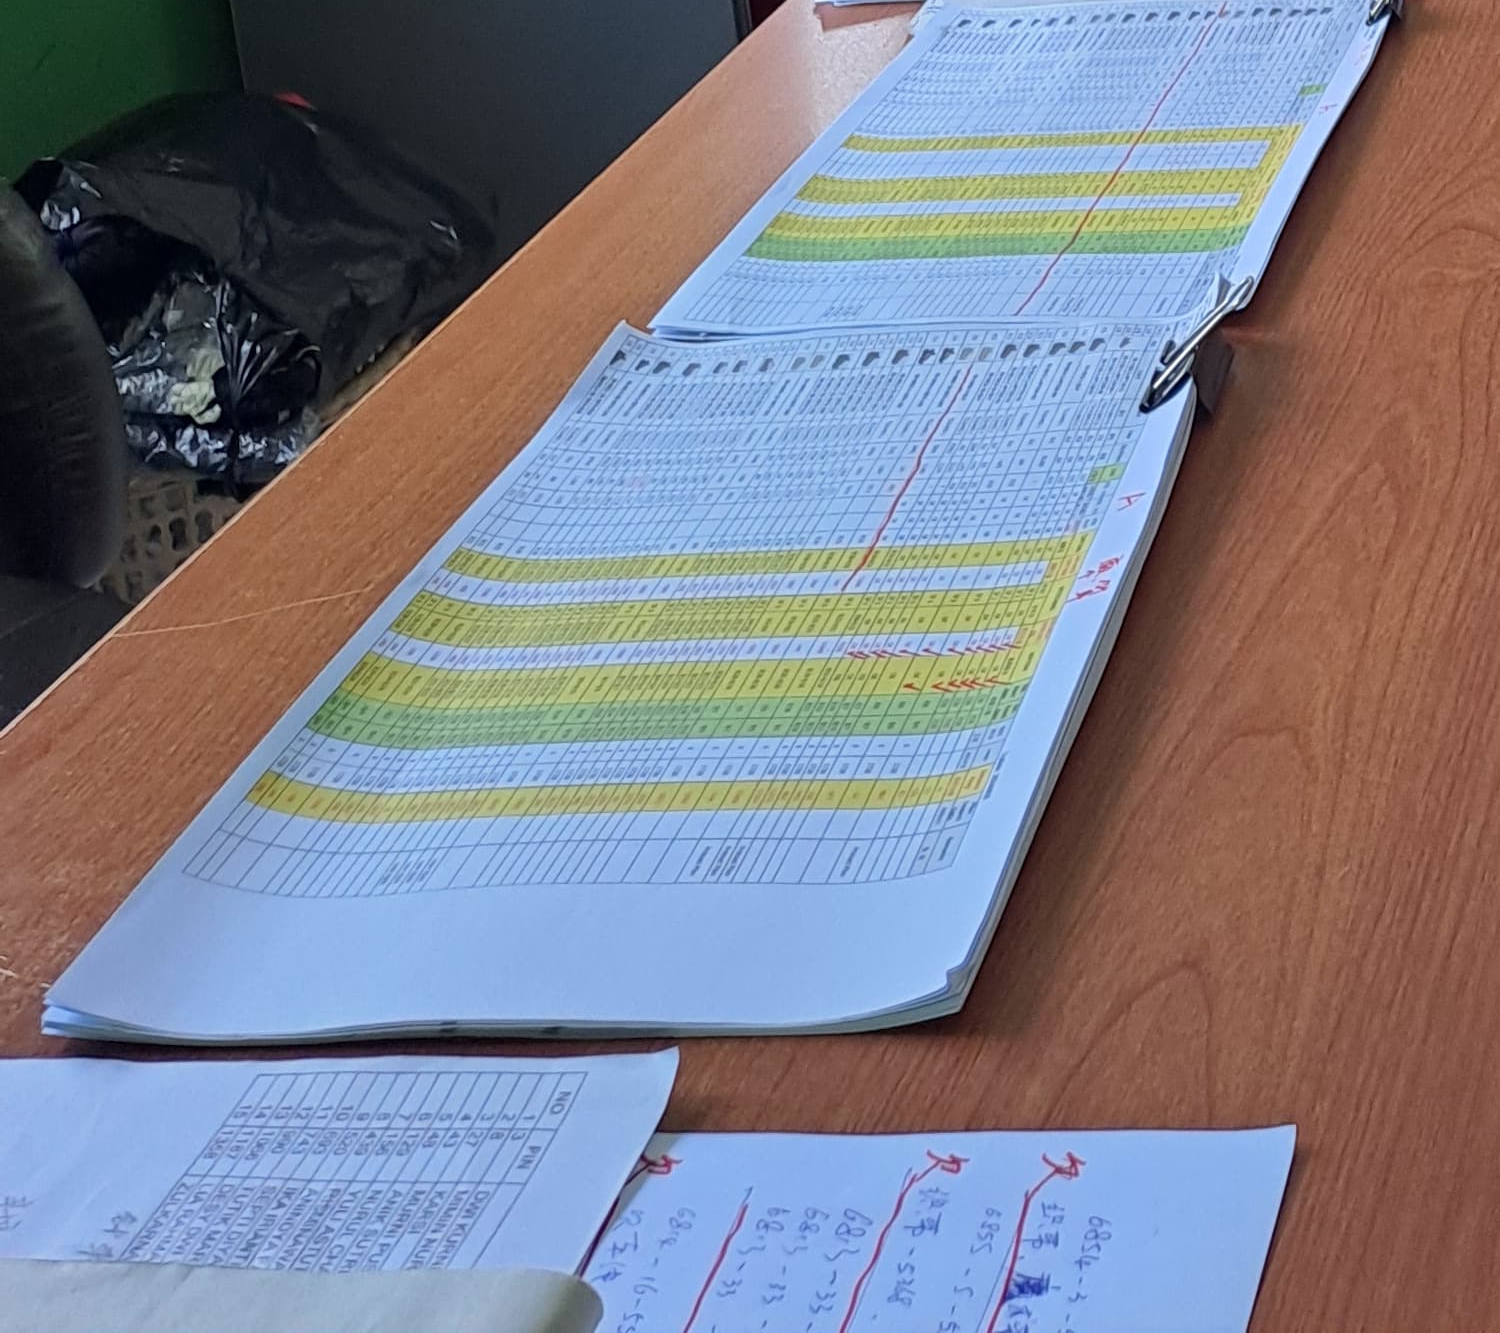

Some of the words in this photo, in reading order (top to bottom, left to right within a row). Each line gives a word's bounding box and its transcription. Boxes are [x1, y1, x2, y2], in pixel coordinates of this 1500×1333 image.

[549, 1091, 572, 1114] NO
[516, 1144, 541, 1169] PIN
[270, 1186, 298, 1210] IKA
[328, 1189, 362, 1222] YULI
[339, 1189, 383, 1238] NURUL
[371, 1188, 402, 1223] ANIK
[383, 1189, 426, 1238] MURNI
[460, 1190, 490, 1219] DWI
